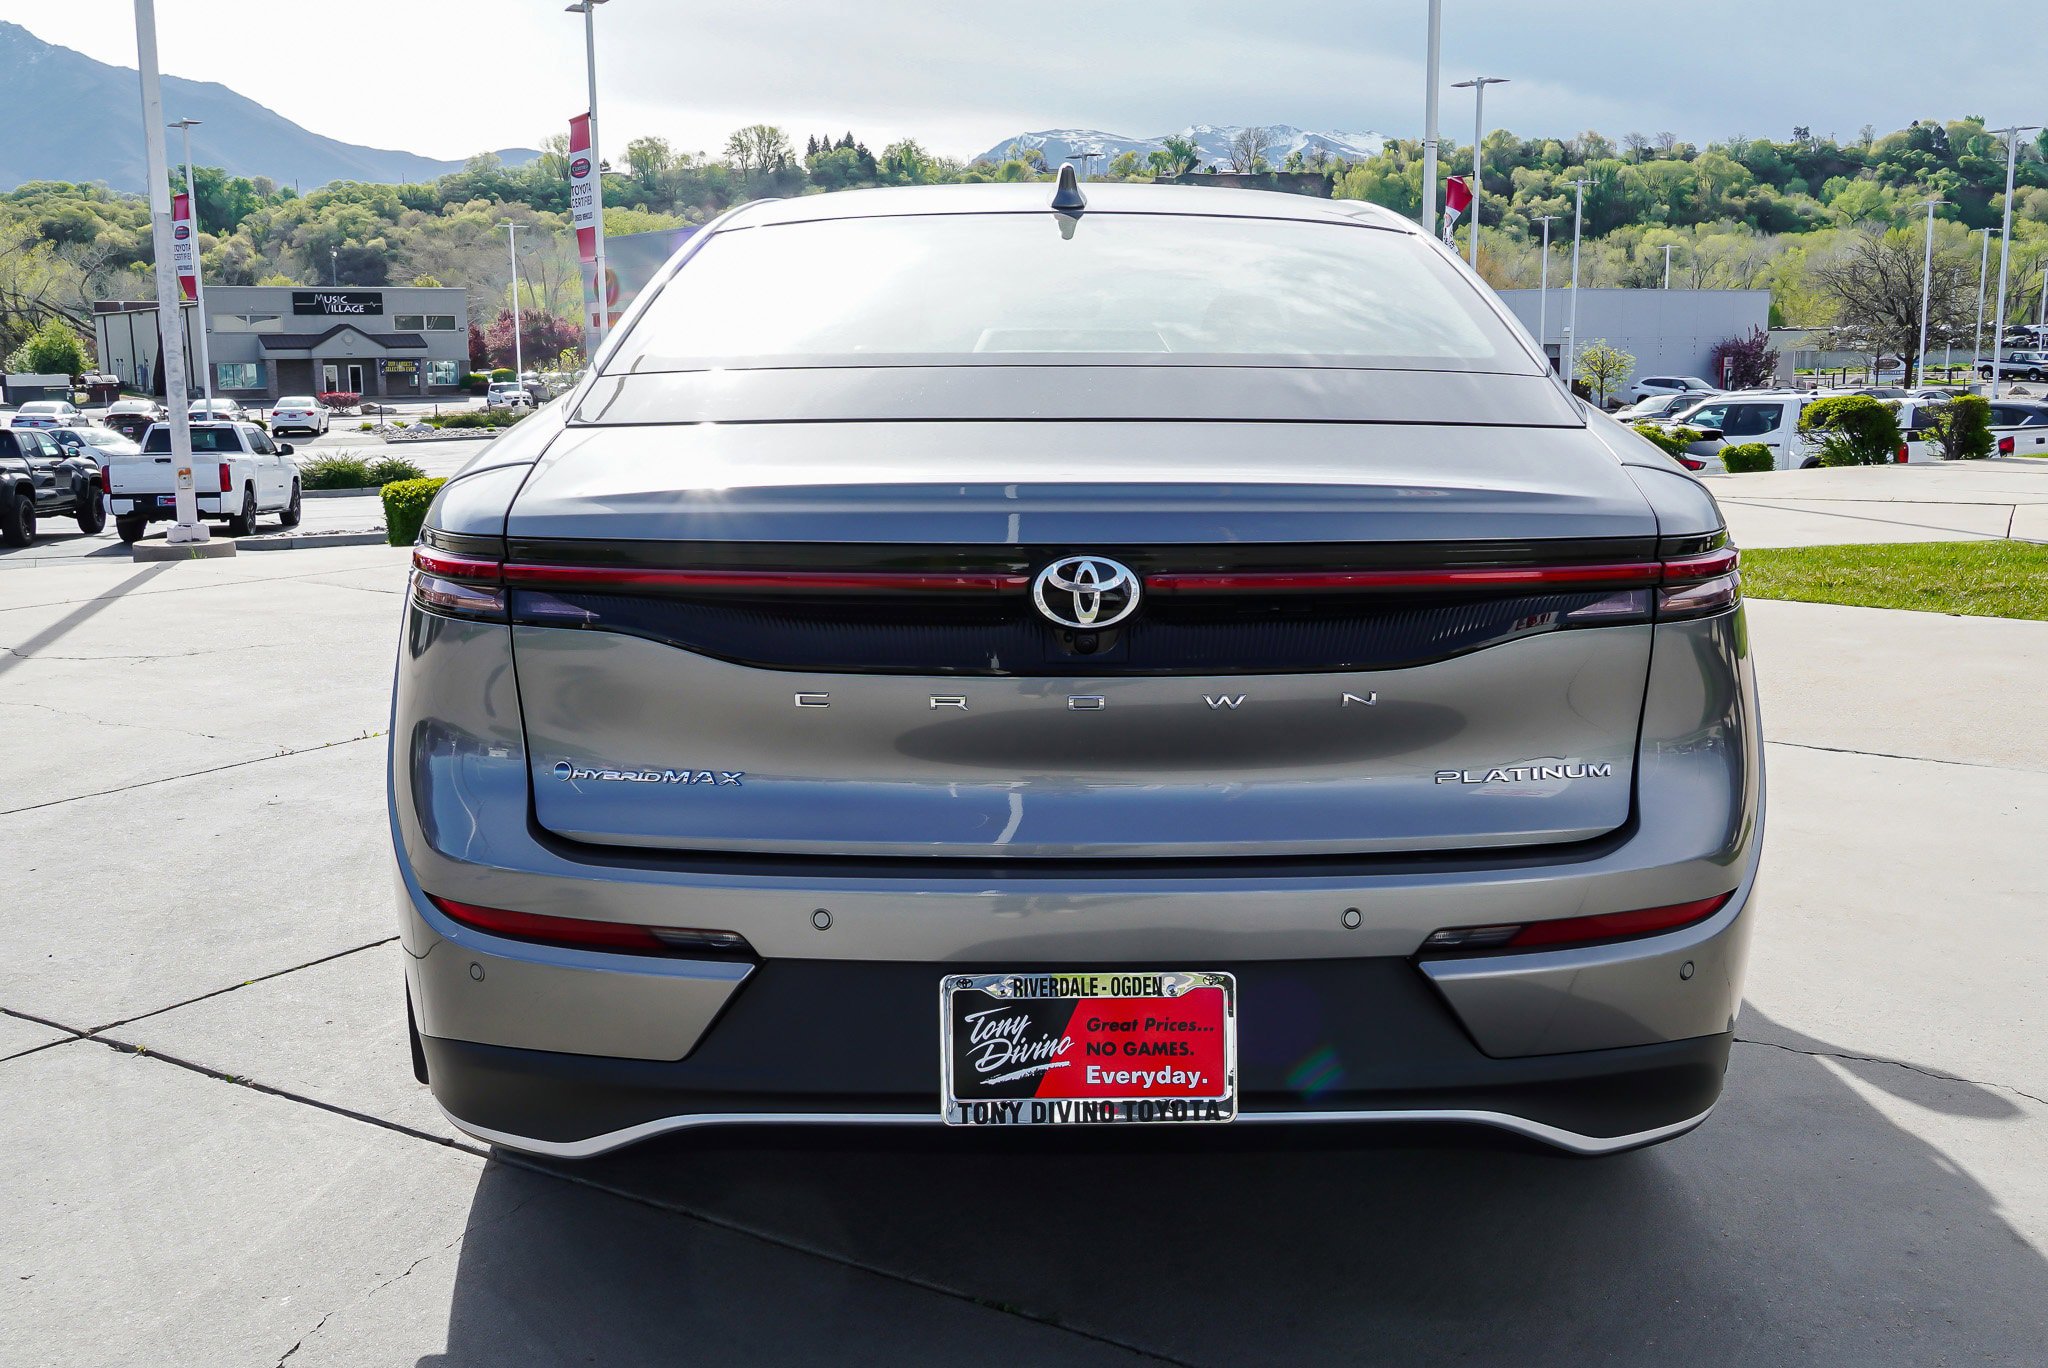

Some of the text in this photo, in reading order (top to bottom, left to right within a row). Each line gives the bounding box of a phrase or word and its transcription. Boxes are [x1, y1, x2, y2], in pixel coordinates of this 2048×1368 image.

[571, 182, 591, 196] TOYOTA
[571, 195, 592, 208] CERTIFIED
[314, 293, 348, 304] MUSIC
[322, 303, 365, 314] VILLAGE
[794, 690, 1378, 711] CROWN
[1434, 763, 1612, 785] PLATINUM
[1013, 977, 1098, 997] RIVERDALE
[1110, 976, 1163, 997] OGDEN
[965, 1006, 1031, 1045] Tony
[1086, 1017, 1214, 1033] Great Prices...
[965, 1033, 1075, 1073] Divino
[1086, 1041, 1195, 1057] NO GAMES.
[1086, 1065, 1208, 1089] Everyday.
[957, 1099, 1222, 1125] TONY DIVINO TOYOTA
